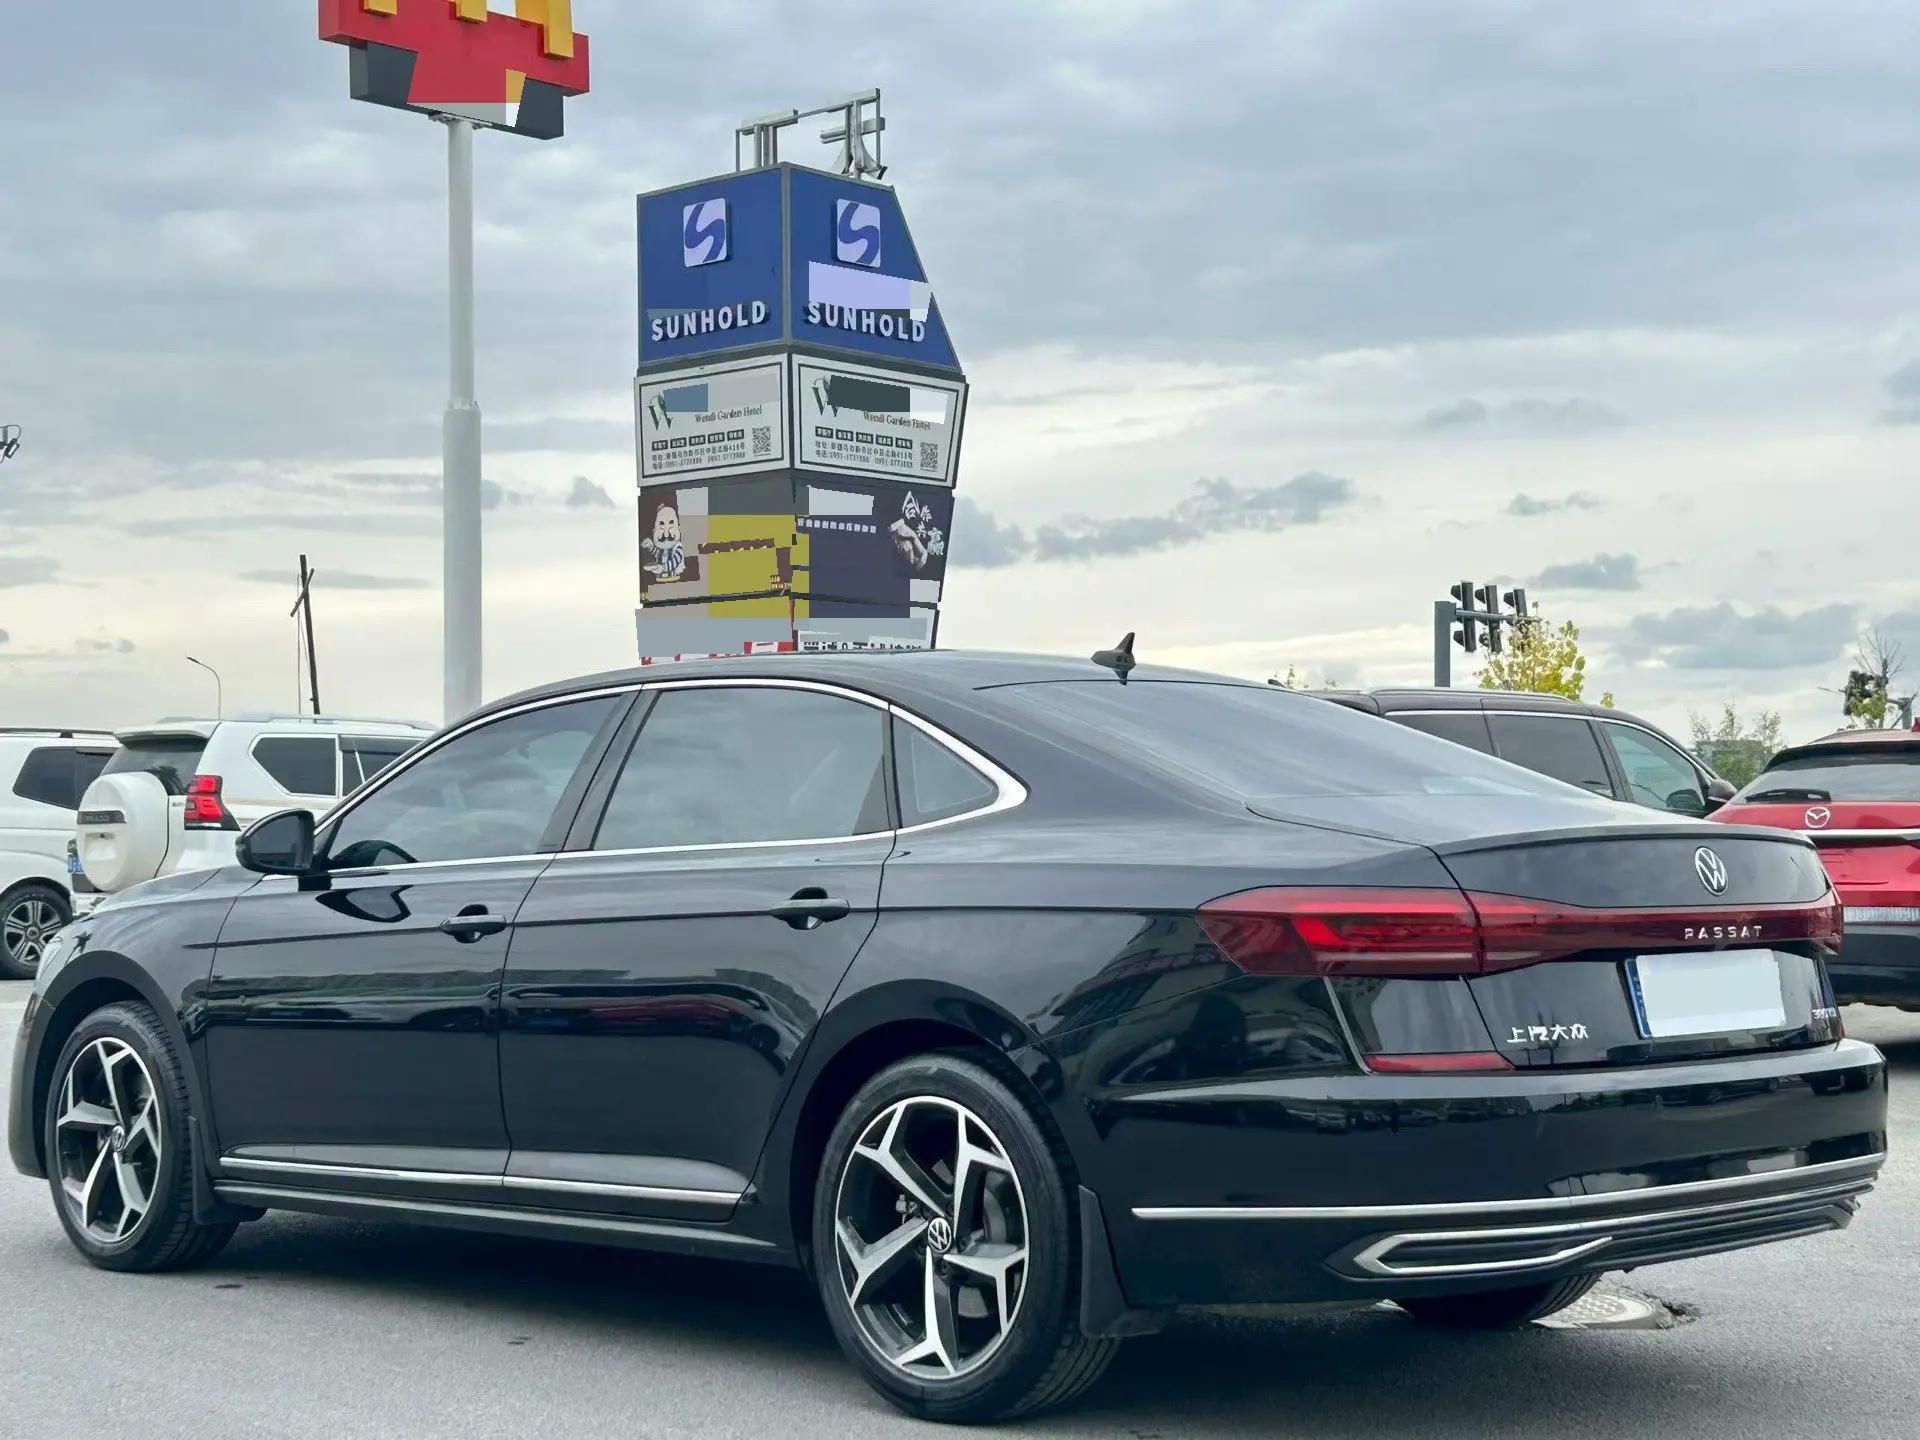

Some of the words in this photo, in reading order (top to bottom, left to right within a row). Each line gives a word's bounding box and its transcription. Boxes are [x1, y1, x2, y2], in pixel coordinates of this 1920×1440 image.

[651, 301, 766, 342] SUNHOLD
[808, 301, 925, 342] SUNHOLD
[717, 408, 742, 421] Garden
[743, 405, 762, 416] Hotel
[886, 414, 911, 428] Garden
[912, 418, 931, 431] Hotel
[1684, 926, 1762, 940] PASSAT
[1507, 1023, 1589, 1043] 上汽大众
